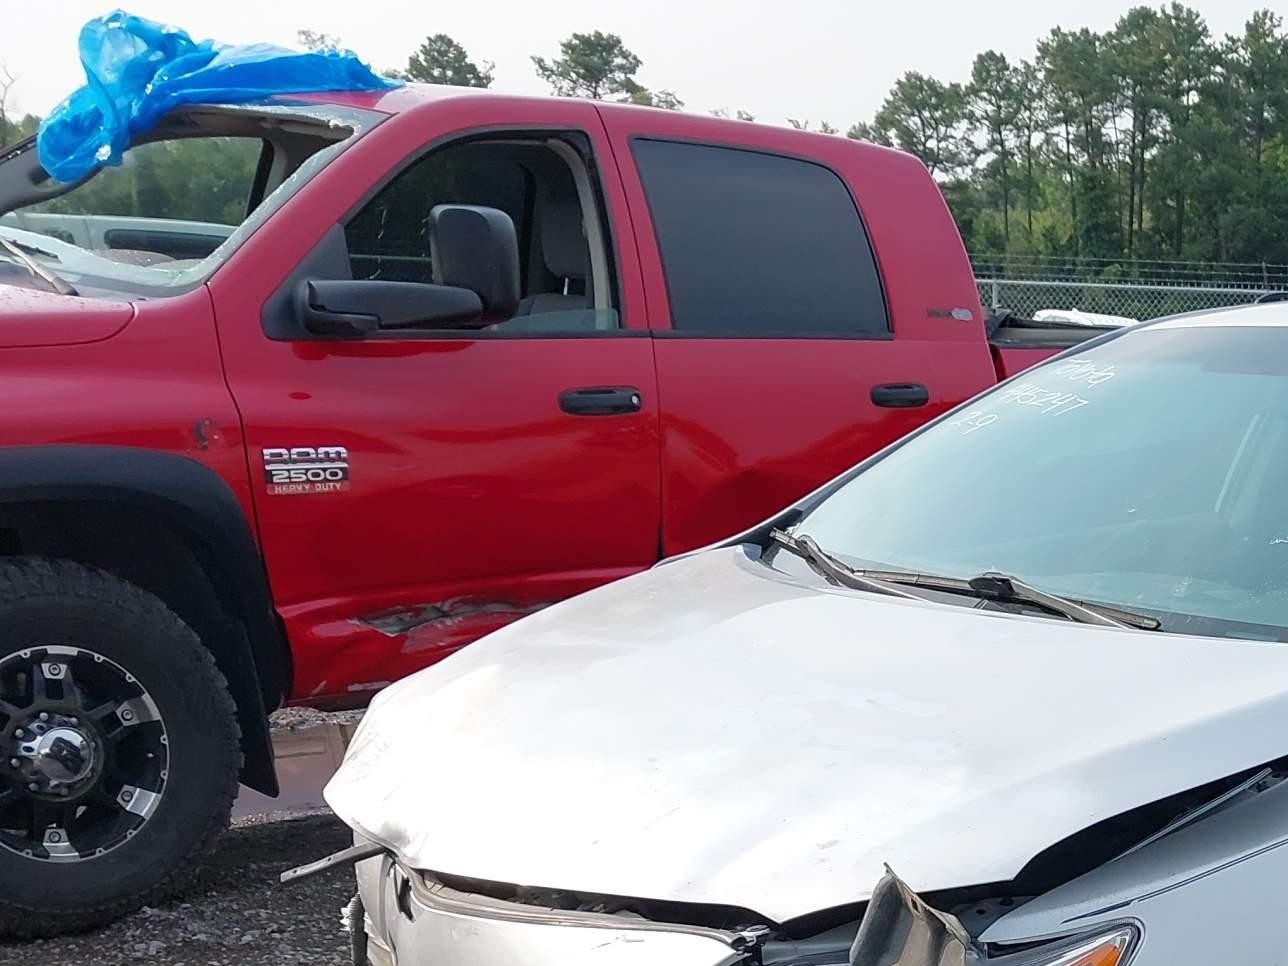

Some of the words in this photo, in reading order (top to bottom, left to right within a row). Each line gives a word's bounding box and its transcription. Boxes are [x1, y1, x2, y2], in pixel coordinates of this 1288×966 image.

[262, 447, 348, 465] RAM
[271, 468, 343, 483] 2500
[273, 483, 311, 495] HEAVY
[314, 481, 341, 492] DUTY
